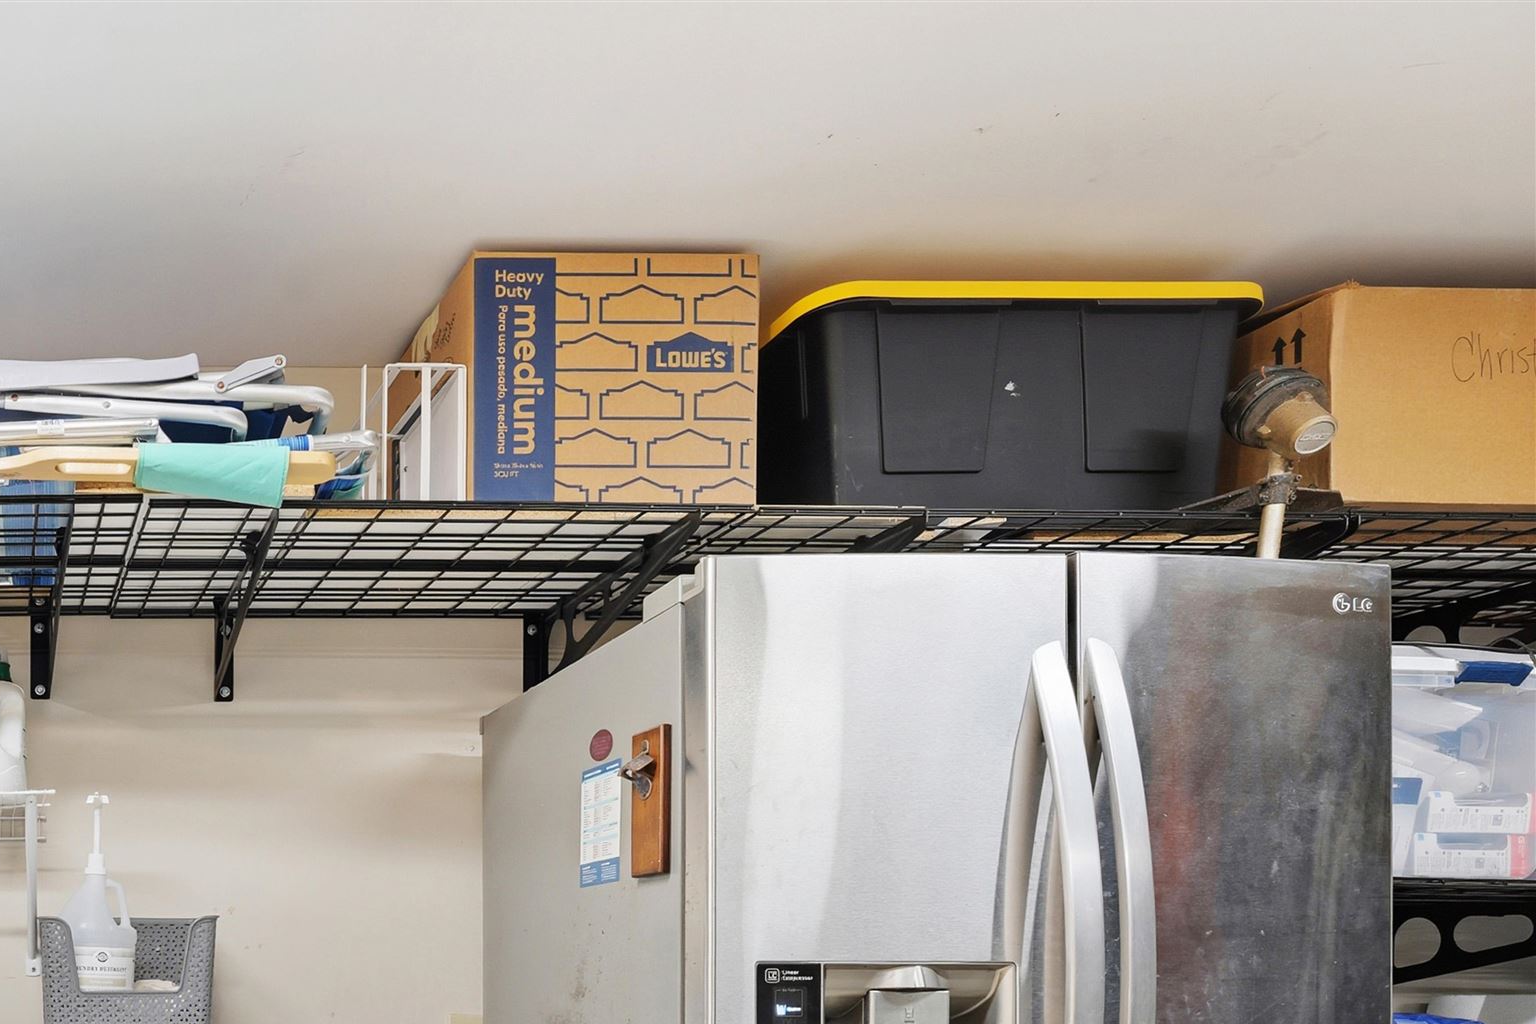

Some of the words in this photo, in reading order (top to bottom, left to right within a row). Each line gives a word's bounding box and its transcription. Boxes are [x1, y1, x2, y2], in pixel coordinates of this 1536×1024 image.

[495, 269, 544, 285] Heavy
[495, 284, 532, 300] Duty
[497, 305, 508, 332] Para
[498, 334, 506, 355] uso
[655, 347, 726, 369] LOWE'S
[496, 356, 508, 400] pesado,
[513, 304, 545, 454] medium
[497, 404, 508, 454] mediana
